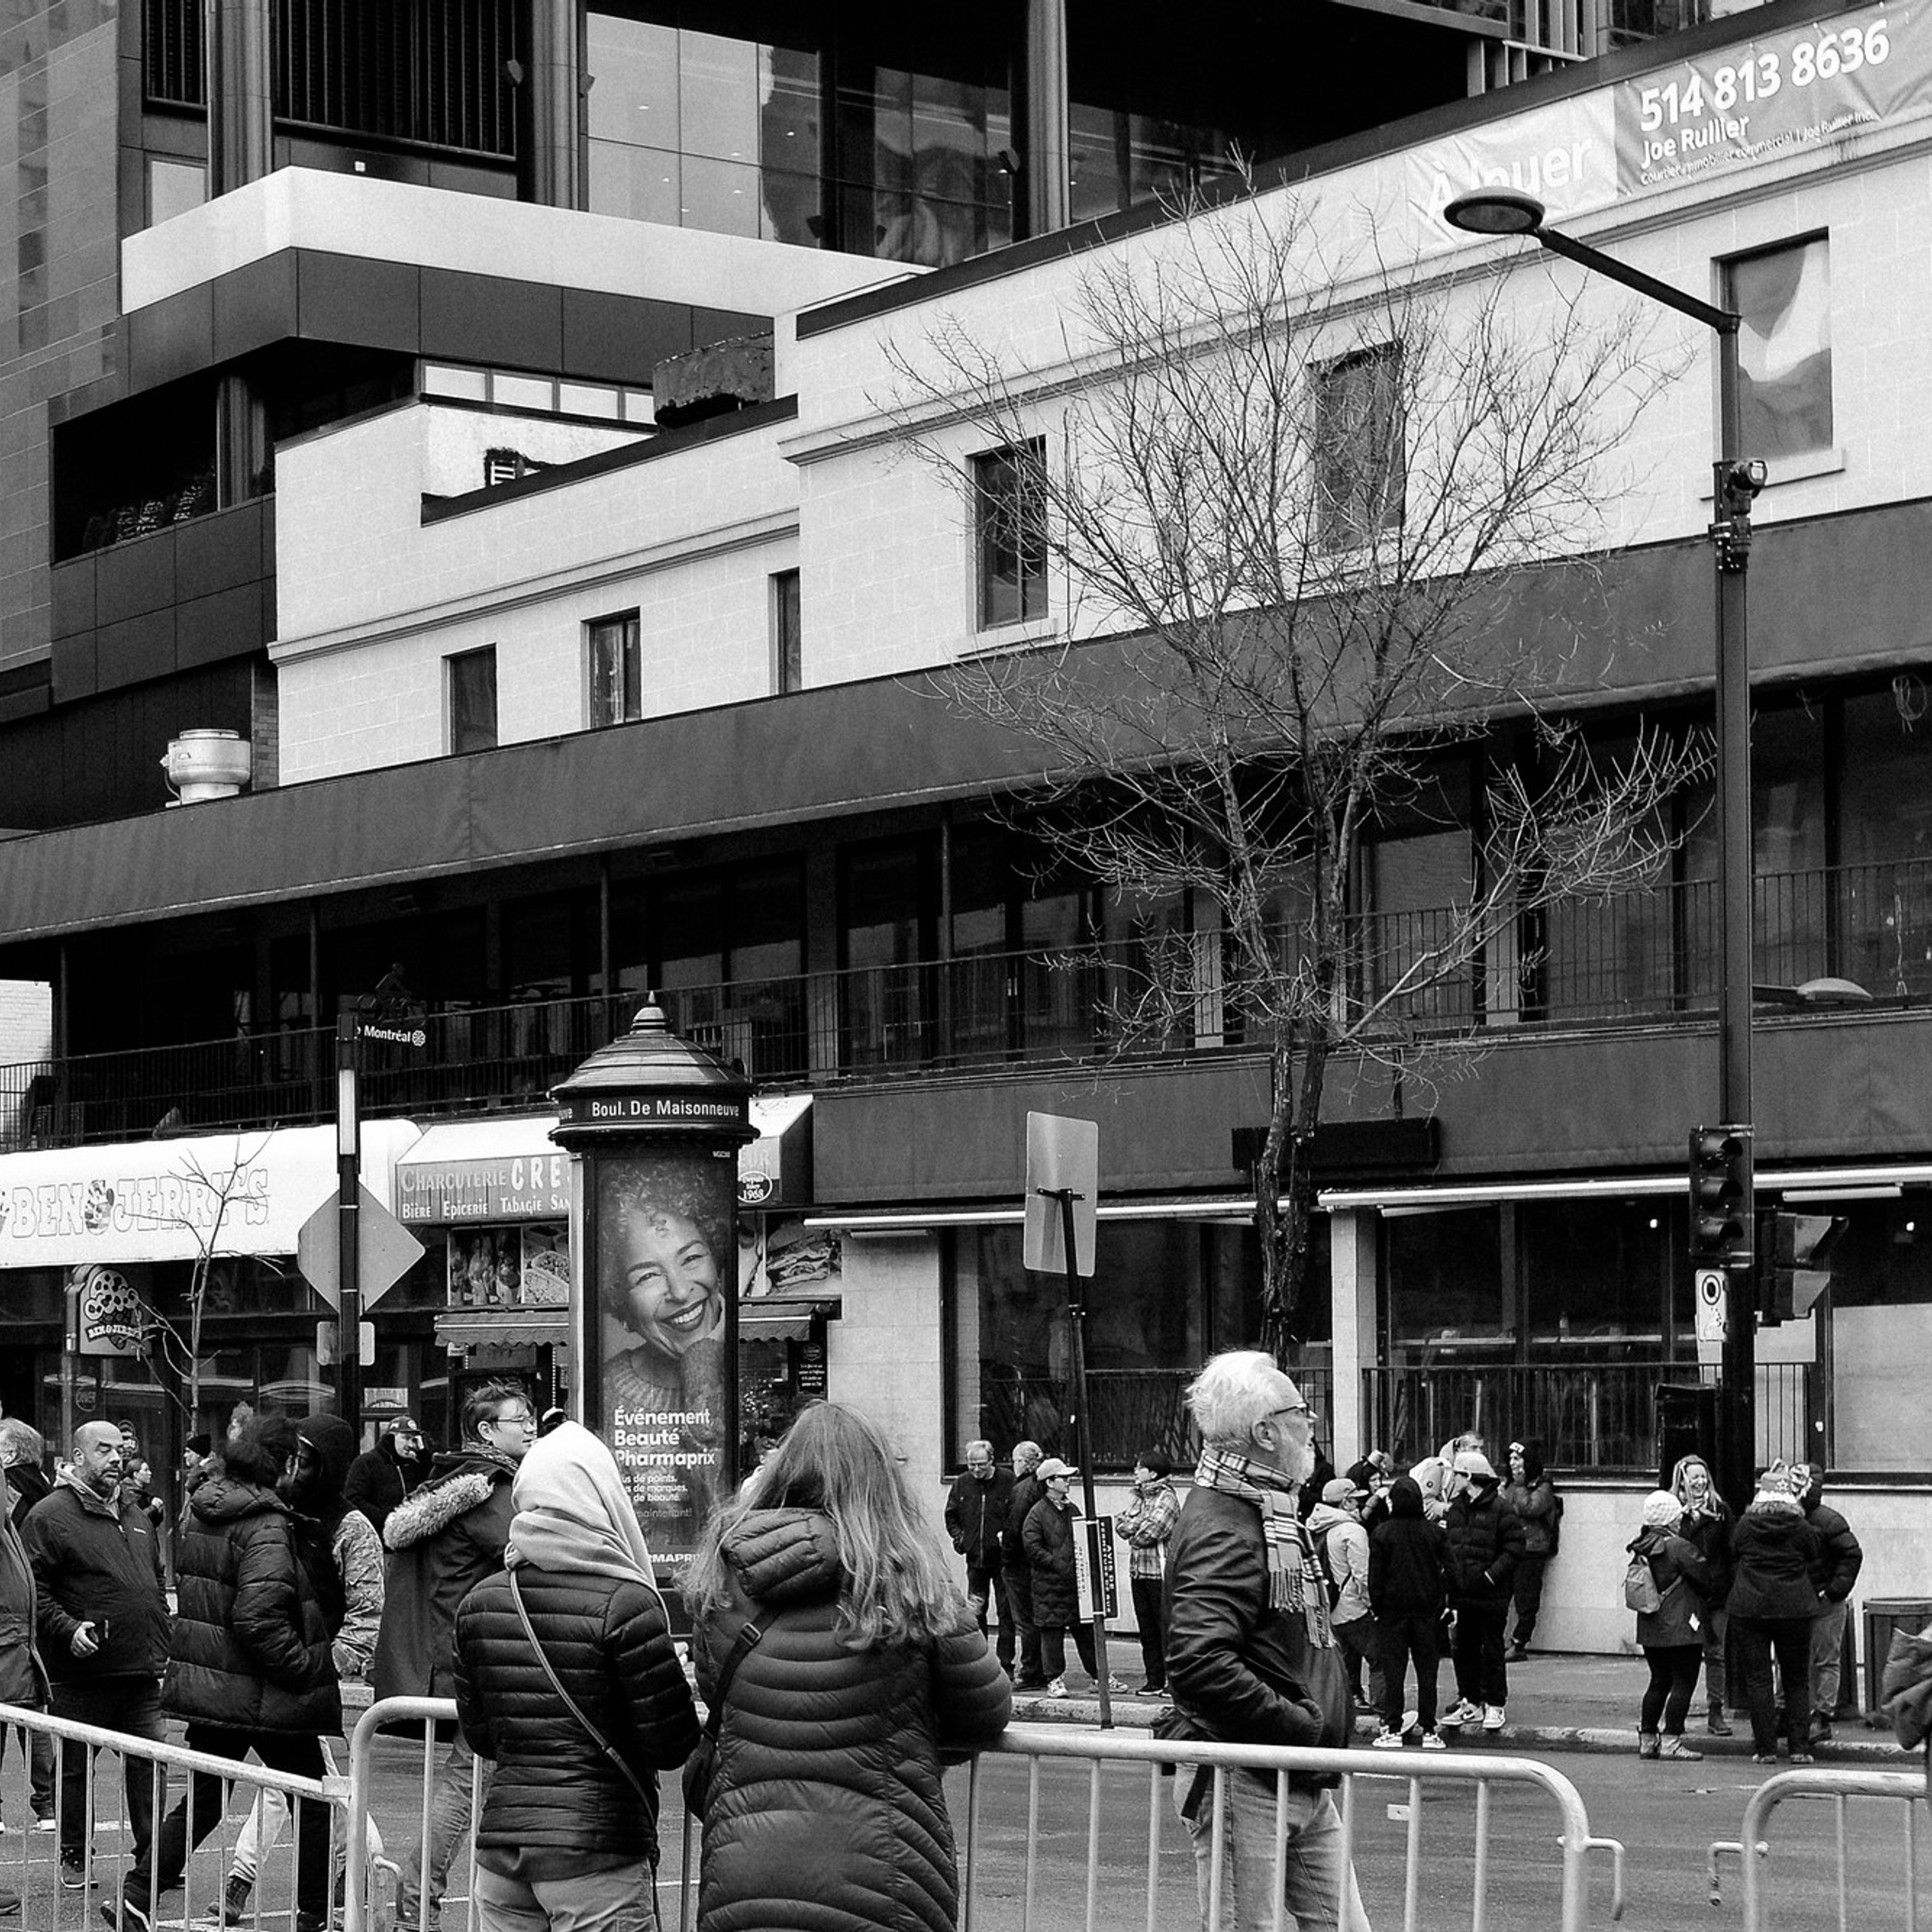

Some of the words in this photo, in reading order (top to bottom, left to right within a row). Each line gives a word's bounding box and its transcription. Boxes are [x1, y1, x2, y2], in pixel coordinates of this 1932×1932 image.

[1641, 74, 1704, 131] 514
[1714, 53, 1781, 110] 813
[1791, 18, 1890, 86] 8636
[1641, 137, 1676, 169] Joe
[1681, 116, 1749, 152] Rullier
[364, 1024, 411, 1042] Montréal
[592, 1100, 626, 1117] Boul.
[630, 1100, 651, 1115] De
[657, 1100, 740, 1117] Maisonneuve
[511, 1155, 572, 1190] CRE
[12, 1183, 84, 1238] BEN
[614, 1404, 710, 1426] Événement
[614, 1427, 680, 1446] Beauté
[615, 1447, 715, 1469] Pharmaprix
[633, 1475, 645, 1484] de
[633, 1484, 645, 1493] de
[633, 1494, 645, 1502] de
